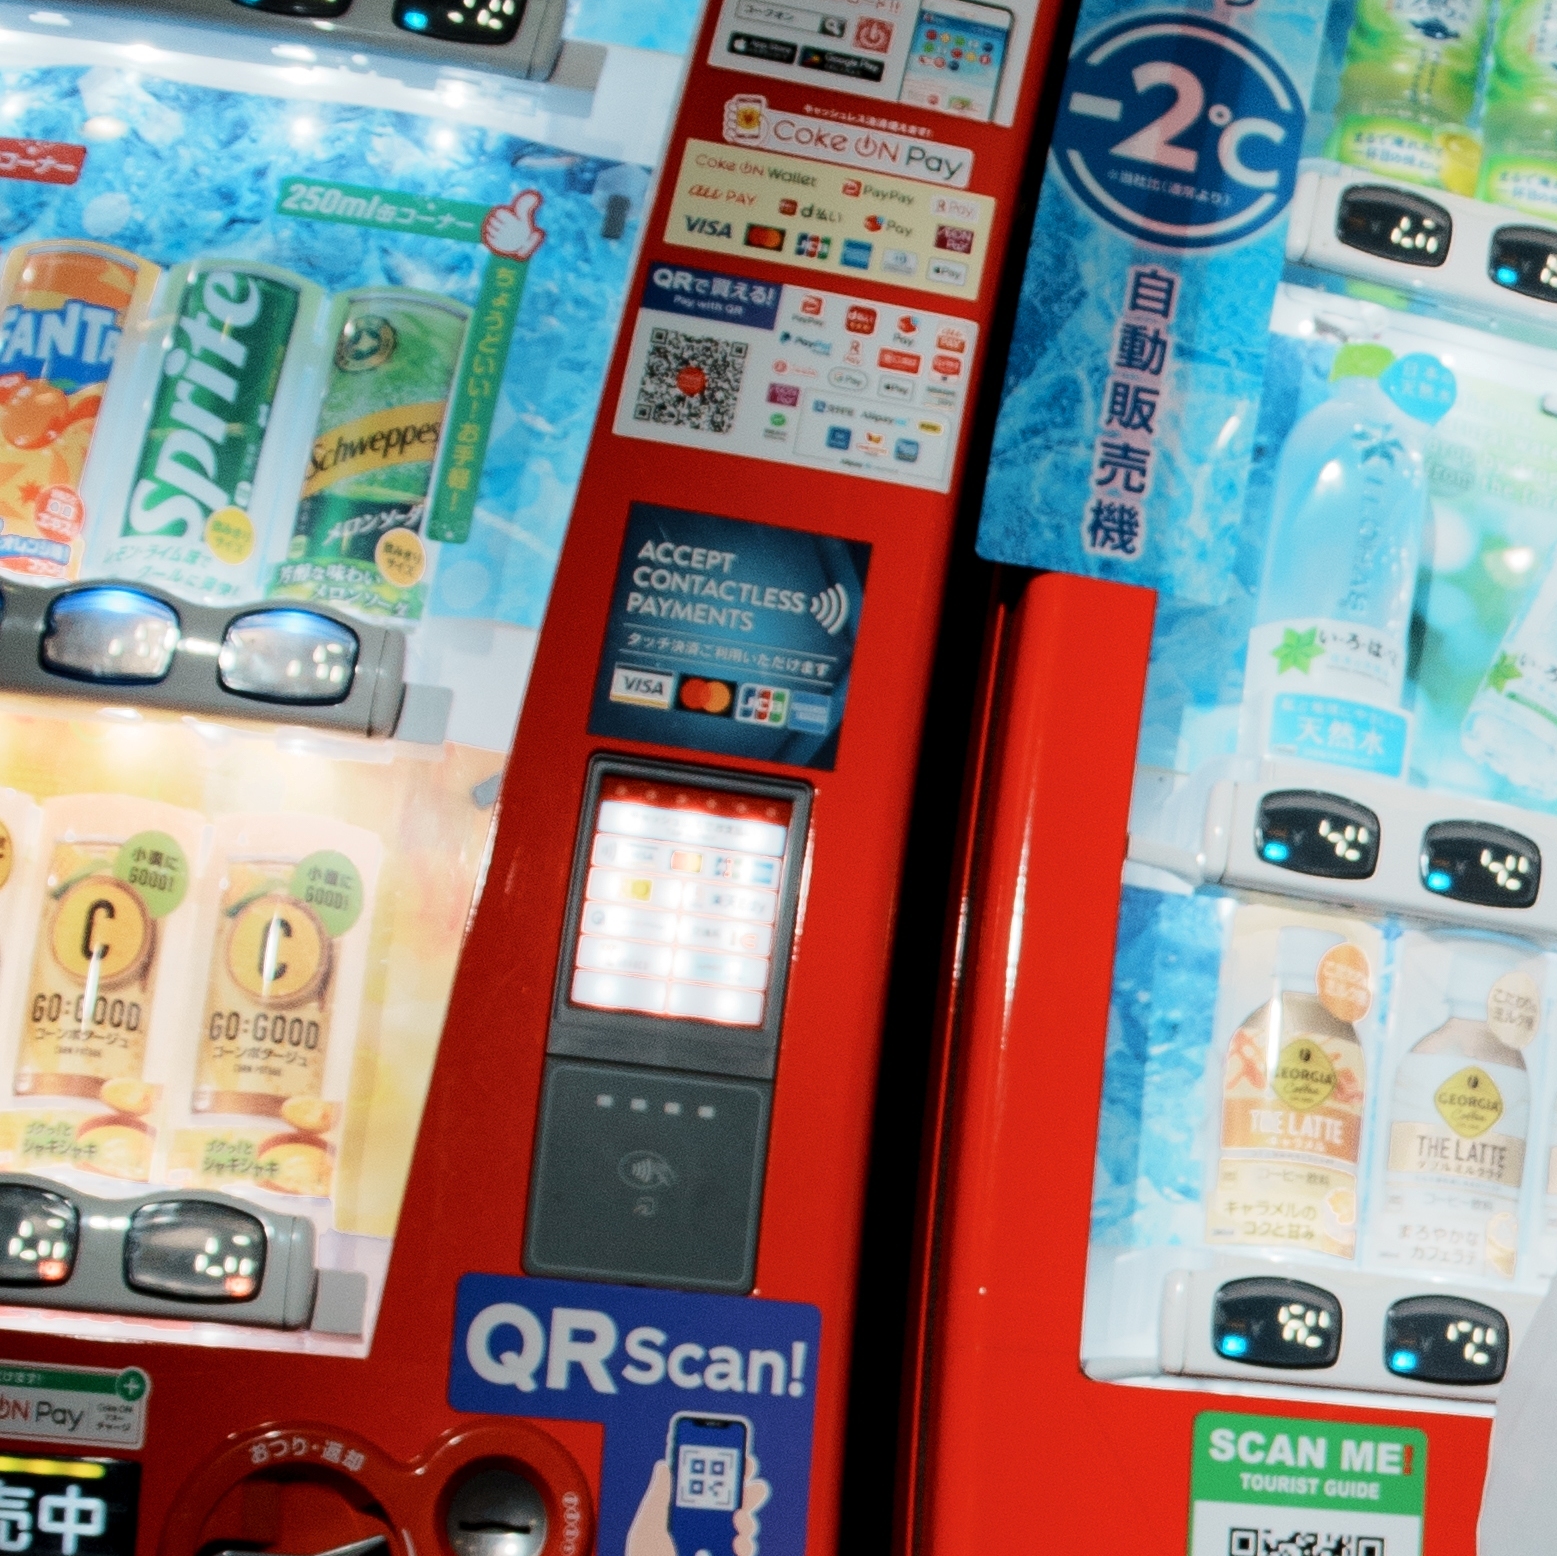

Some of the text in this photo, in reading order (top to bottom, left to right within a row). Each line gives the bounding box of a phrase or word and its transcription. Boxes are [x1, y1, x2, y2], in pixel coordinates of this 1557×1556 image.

[773, 118, 851, 155] Coke
[905, 145, 965, 181] Pay
[695, 153, 736, 172] Coke
[767, 166, 818, 189] Wallet
[862, 183, 914, 207] PayPay
[683, 213, 735, 241] VISA
[652, 267, 777, 307] QRで買える!
[129, 270, 262, 544] Sprite
[1085, 264, 1180, 558] 自動販売機
[305, 419, 443, 484] Schweppes
[636, 539, 738, 577] ACCEPT
[631, 564, 805, 616] CONTACTLESS
[625, 592, 756, 633] PAYMENTS
[619, 673, 668, 697] VISA
[1296, 714, 1387, 756] 天然水
[81, 899, 116, 962] C
[257, 918, 293, 981] C
[1437, 1093, 1500, 1112] GEORGIA
[1288, 1115, 1345, 1146] LATTE
[1416, 1134, 1508, 1170] THE LATTE
[1223, 1199, 1319, 1221] キャラメルの
[1243, 1220, 1316, 1241] コクと甘み
[1397, 1224, 1480, 1247] まろやかな
[1410, 1245, 1480, 1267] カフェラテ
[465, 1303, 807, 1398] QR Scan!
[34, 1399, 85, 1432] Pay
[249, 1435, 366, 1473] おつり・返却
[1207, 1427, 1415, 1476] SCAN ME!
[1239, 1471, 1381, 1501] TOURIST GUIDE
